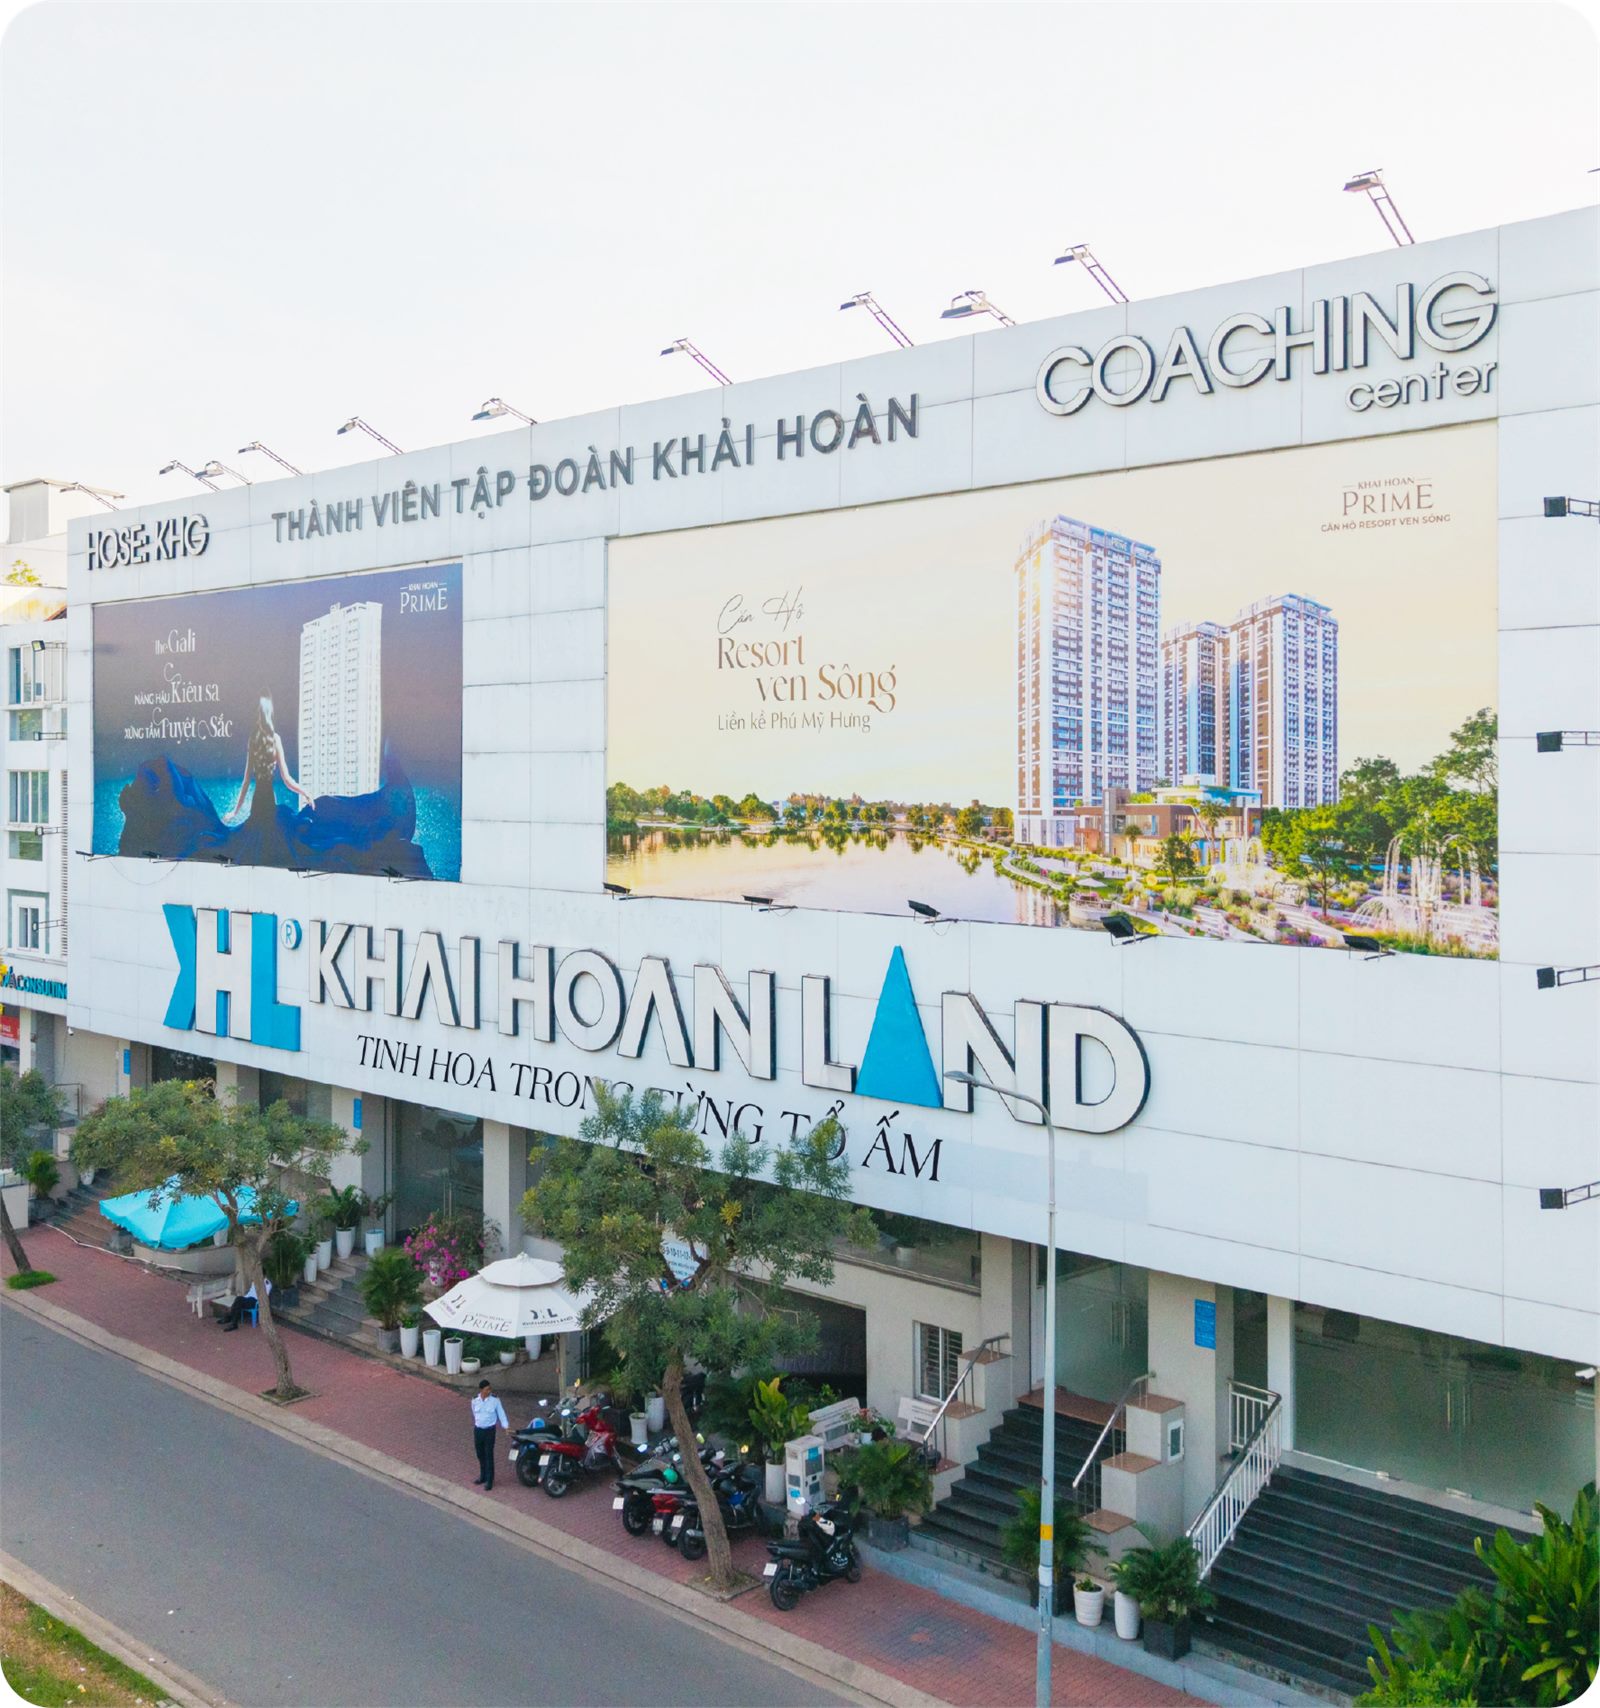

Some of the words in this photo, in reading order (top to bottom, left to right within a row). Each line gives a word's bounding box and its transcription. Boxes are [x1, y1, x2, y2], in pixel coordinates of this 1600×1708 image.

[1035, 271, 1497, 415] COACHING
[1344, 359, 1498, 413] center
[271, 498, 363, 543] THÀNH
[371, 480, 441, 527] VIÊN
[451, 466, 516, 519] TẬP
[527, 445, 634, 501] ĐOÀN
[652, 417, 755, 481] KHẢI
[777, 393, 920, 461] HOÀN
[1358, 480, 1382, 490] KHAI
[1342, 484, 1433, 516] PRIME
[154, 513, 211, 561] KHG
[1359, 518, 1397, 529] RESORT
[1400, 516, 1419, 526] VEN
[400, 588, 448, 614] PRIME
[168, 628, 196, 653] Gali
[718, 635, 805, 669] Resort
[205, 684, 220, 702] sa
[756, 675, 807, 702] ven
[818, 663, 897, 714] Sông
[771, 711, 797, 729] Phú
[801, 711, 824, 734] Mỹ
[830, 711, 871, 734] Hưng
[308, 919, 481, 1029] KHAI
[498, 939, 776, 1080] HOAN
[801, 946, 1151, 1134] LAND
[357, 1034, 422, 1077] TINH
[429, 1048, 497, 1092] HOA
[861, 1110, 944, 1182] ẤM
